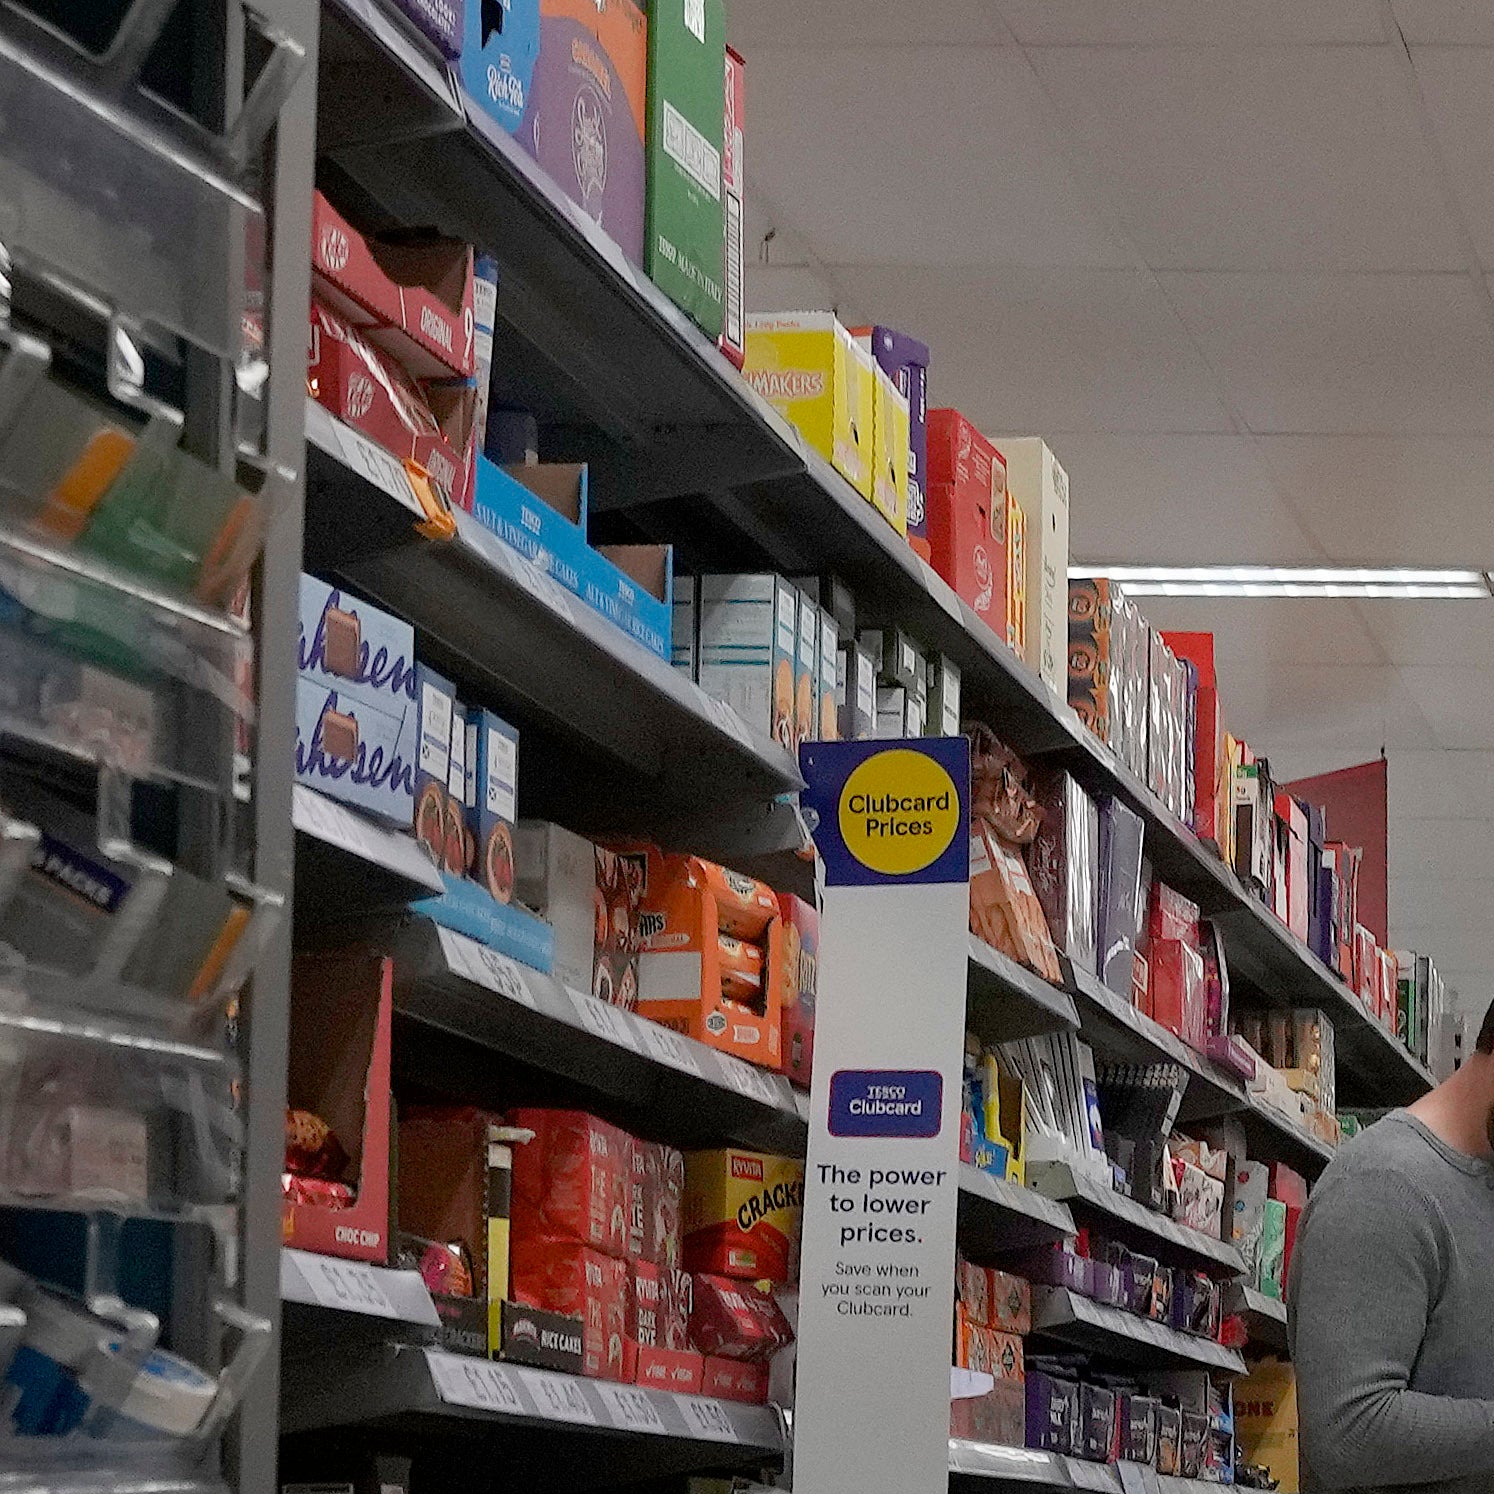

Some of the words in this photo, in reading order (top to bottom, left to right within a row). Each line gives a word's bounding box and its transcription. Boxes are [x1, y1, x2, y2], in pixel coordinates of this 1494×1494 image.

[420, 307, 453, 353] ORIGINAL
[849, 792, 950, 814] Clubcard
[866, 817, 933, 838] Prices
[867, 1085, 906, 1099] TESCO
[849, 1098, 922, 1115] Clubcard
[818, 1165, 860, 1184] The
[869, 1170, 946, 1190] power
[738, 1183, 803, 1230] CRACK
[830, 1195, 855, 1213] to
[863, 1194, 931, 1215] lower
[335, 1225, 358, 1246] CHOC
[360, 1228, 381, 1248] CHIP
[840, 1222, 922, 1247] prices.
[835, 1261, 872, 1276] Save
[876, 1264, 919, 1277] when
[821, 1284, 850, 1297] you
[854, 1285, 892, 1296] scan
[896, 1286, 931, 1299] your
[836, 1301, 913, 1317] Clubcard.
